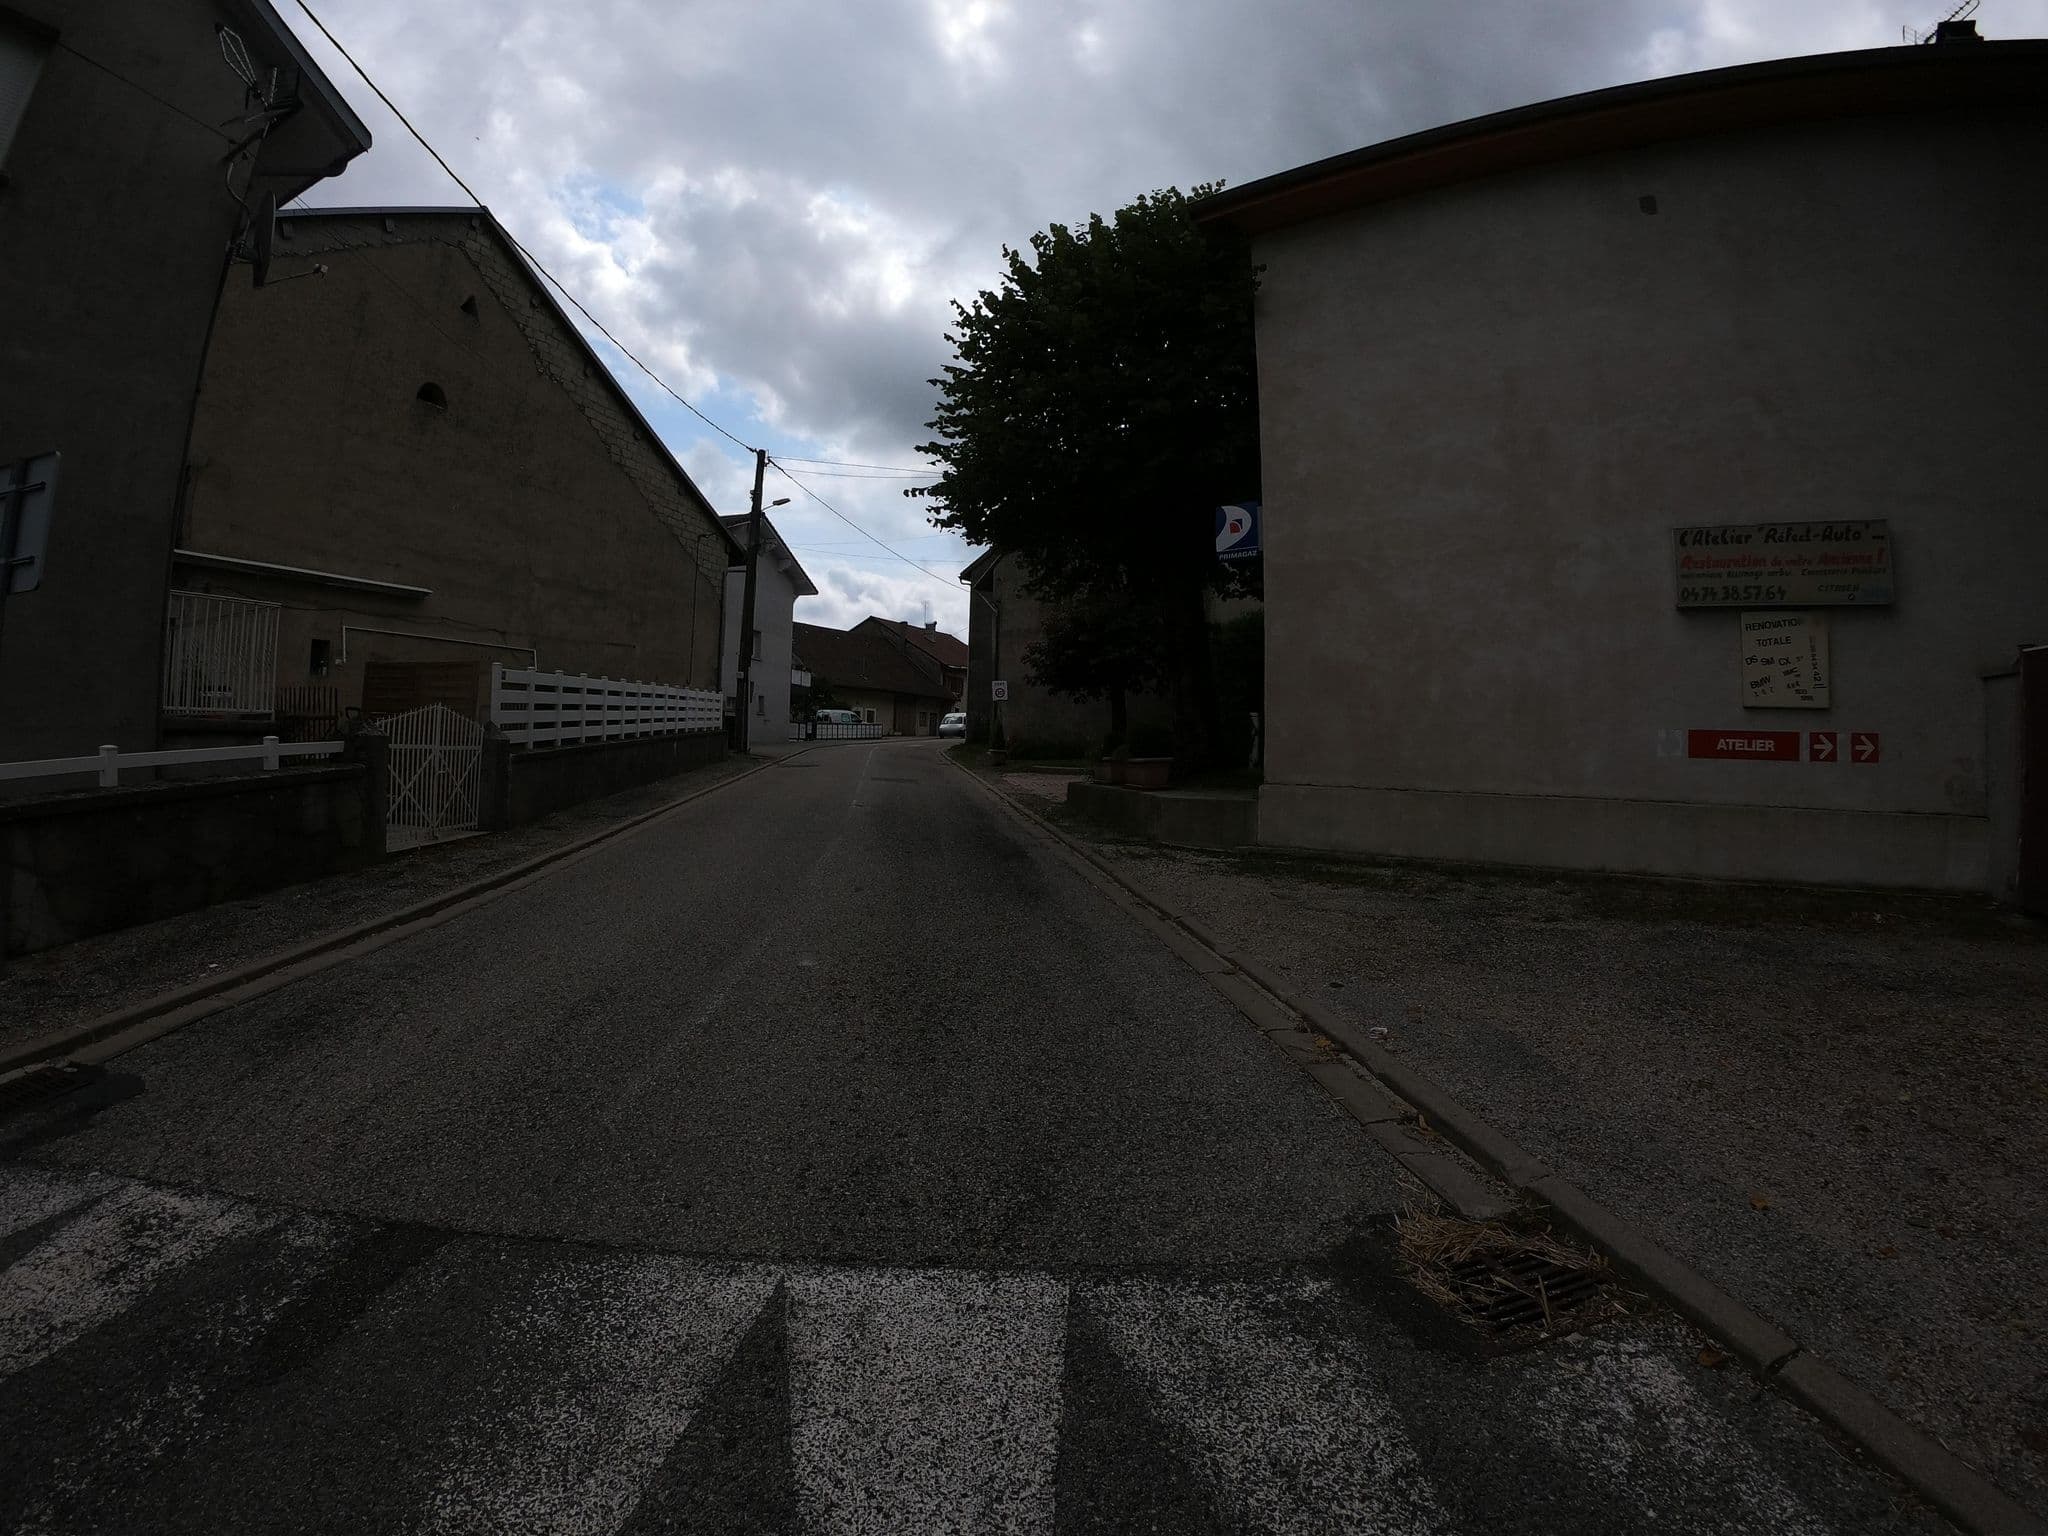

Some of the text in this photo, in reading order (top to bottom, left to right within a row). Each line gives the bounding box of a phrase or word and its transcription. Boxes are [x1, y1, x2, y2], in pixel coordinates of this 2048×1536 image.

[1218, 550, 1258, 561] PRIMAGAZ
[1756, 636, 1793, 648] TOTALE
[1716, 738, 1776, 753] ATELIER
